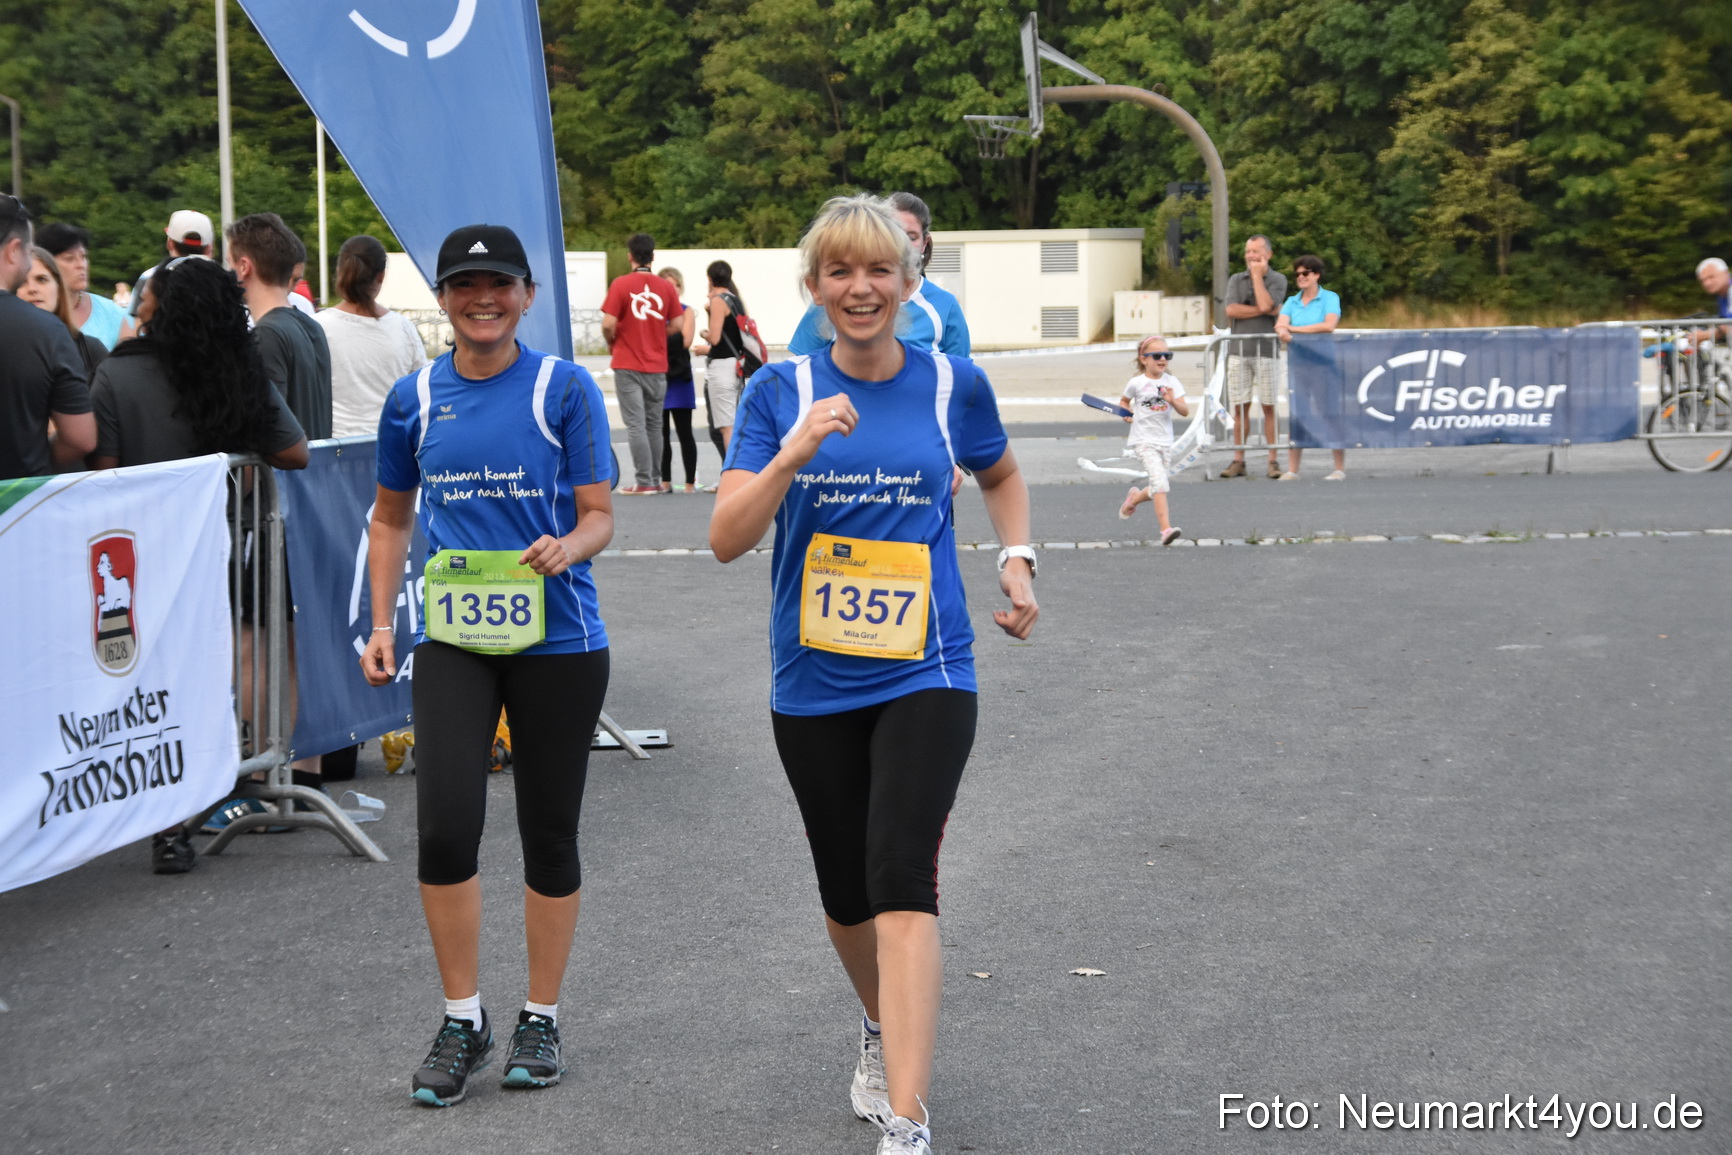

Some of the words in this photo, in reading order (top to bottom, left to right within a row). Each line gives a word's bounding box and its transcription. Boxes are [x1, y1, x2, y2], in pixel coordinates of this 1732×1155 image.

[1395, 378, 1567, 412] Fischer
[436, 413, 457, 421] erima
[1410, 413, 1553, 431] AUTOMOBILE
[484, 465, 526, 481] kommt
[875, 467, 922, 486] kommt
[442, 488, 474, 505] jeder
[477, 487, 505, 499] nach
[508, 482, 545, 500] Hause
[813, 489, 857, 508] jeder
[859, 490, 892, 504] nach
[823, 554, 868, 567] firmenlauf
[437, 592, 532, 626] 1358
[815, 582, 916, 626] 1357
[459, 632, 480, 641] Sigrid
[843, 630, 859, 639] Mila
[860, 631, 878, 640] Graf
[104, 641, 129, 662] 1628
